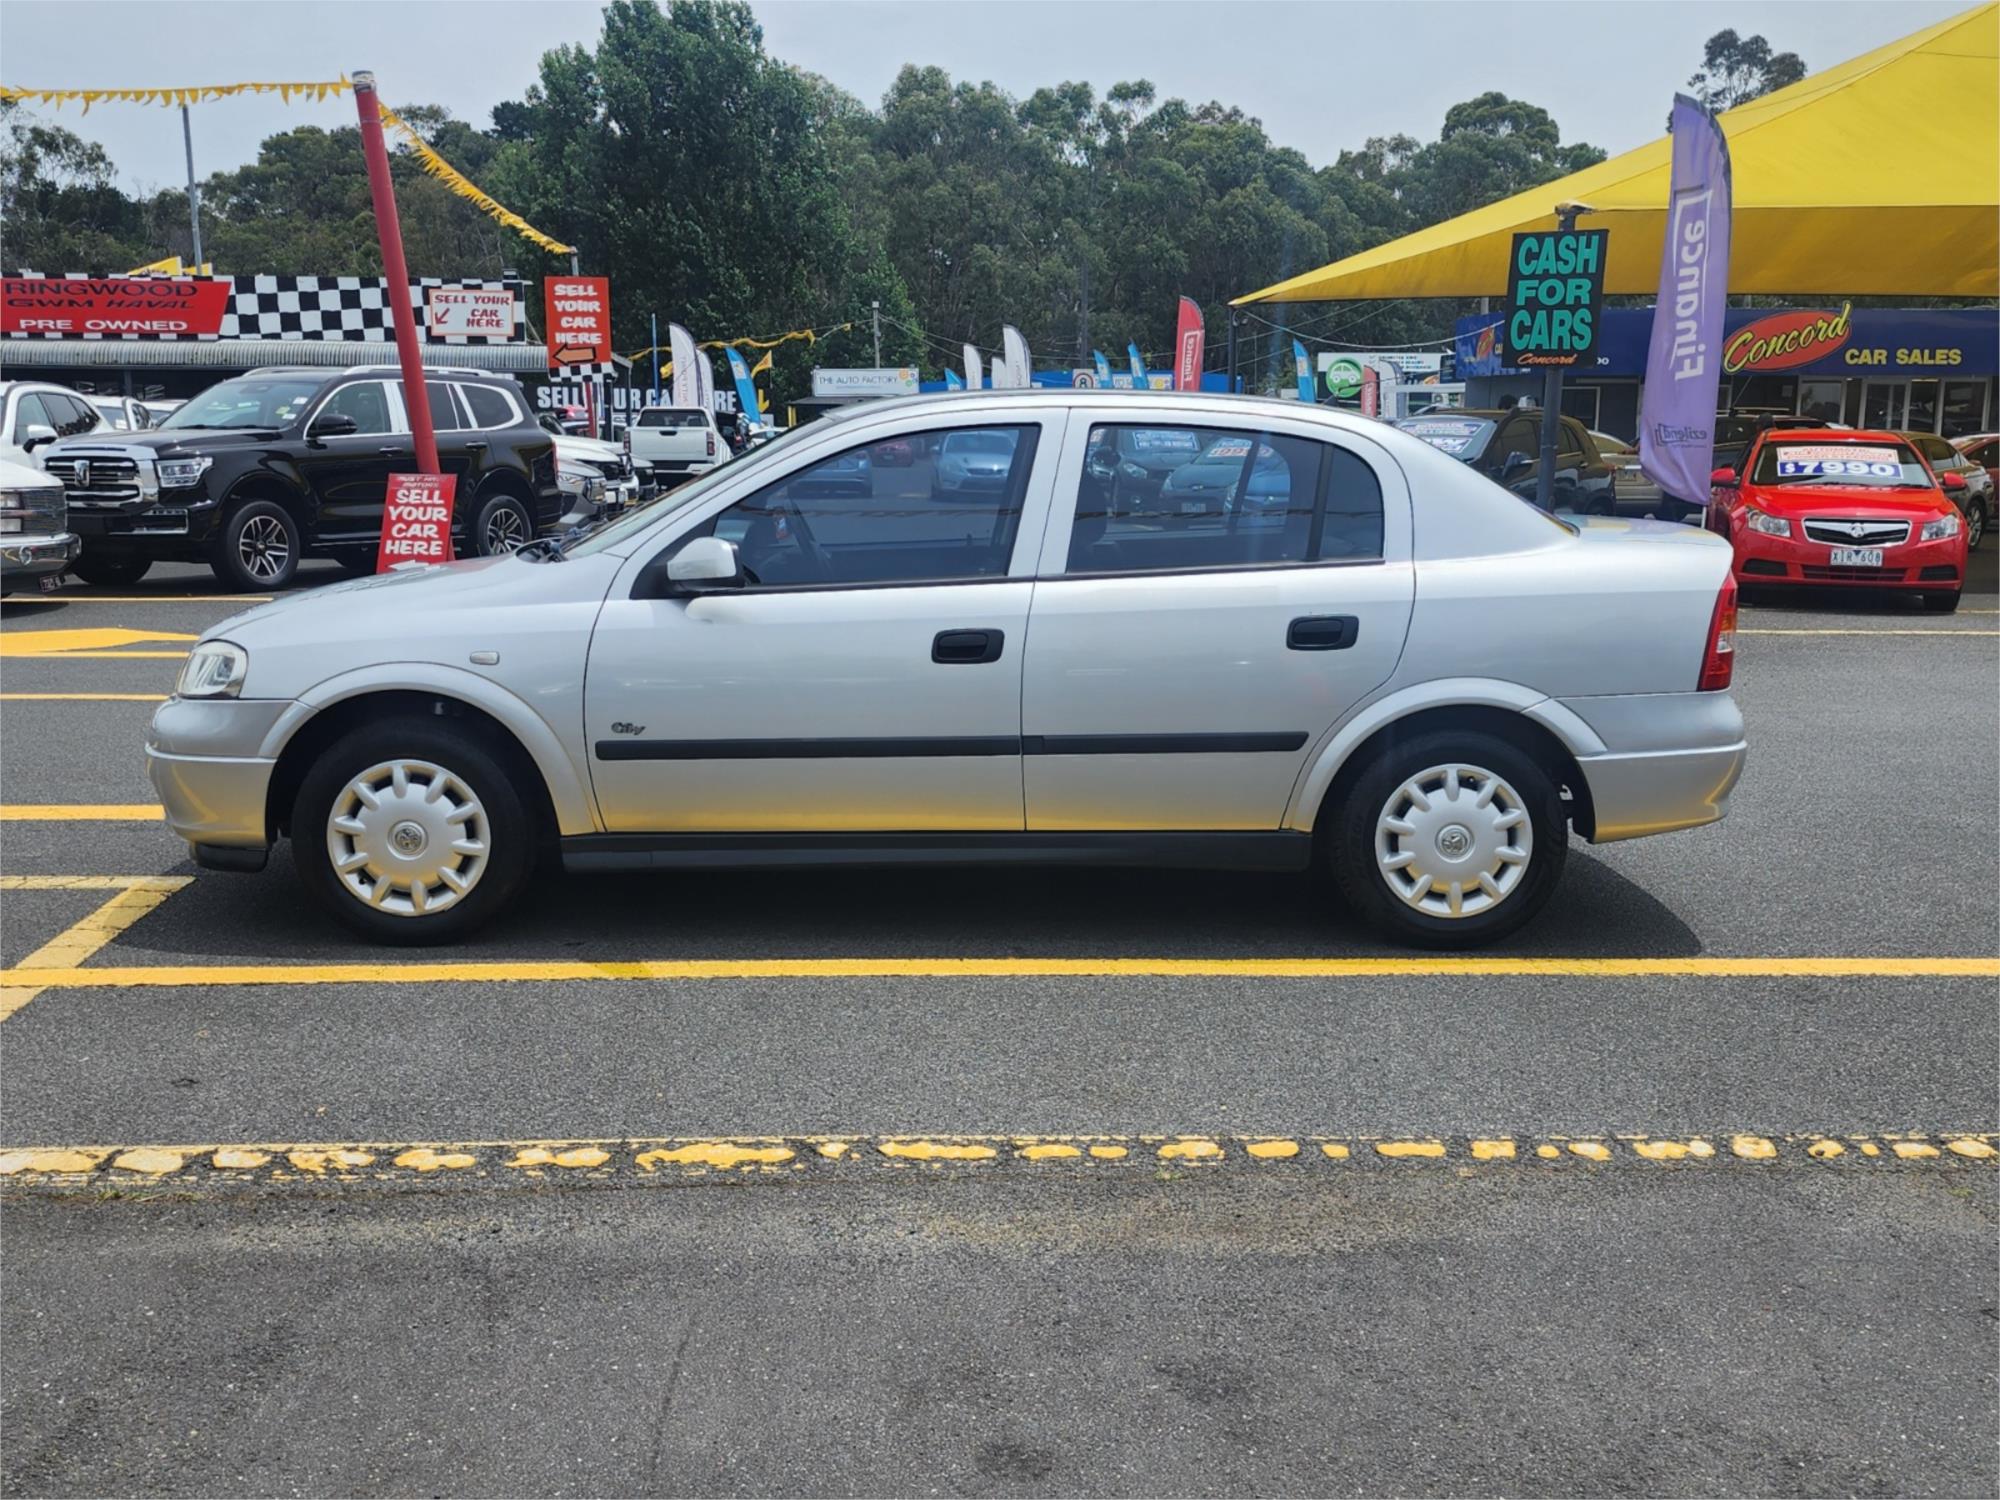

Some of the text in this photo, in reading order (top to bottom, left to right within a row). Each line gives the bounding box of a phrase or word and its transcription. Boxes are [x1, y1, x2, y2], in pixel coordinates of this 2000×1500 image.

[1518, 235, 1600, 275] CASH
[6, 282, 198, 296] RINGWOOD
[554, 284, 597, 296] SELL
[1516, 278, 1592, 306] FOR
[7, 298, 194, 309] GWM HAVAL
[434, 294, 510, 305] SELL YOUR
[554, 300, 601, 312] YOUR
[471, 308, 499, 318] CAR
[19, 319, 188, 331] PRE OWNED
[466, 318, 505, 328] HERE
[560, 316, 597, 328] CAR
[1510, 308, 1592, 350] CARS
[555, 332, 603, 344] HERE
[1722, 300, 1852, 373] Concord
[1517, 353, 1578, 365] Concord
[1844, 349, 1962, 366] CAR SALES
[836, 376, 860, 384] AUTO
[862, 375, 897, 384] FACTORY
[537, 386, 586, 409] SELL
[645, 388, 674, 408] CA
[1785, 461, 1896, 476] $7990
[395, 489, 445, 504] SELL
[388, 506, 448, 522] YOUR
[391, 523, 439, 538] CAR
[385, 540, 443, 555] HERE
